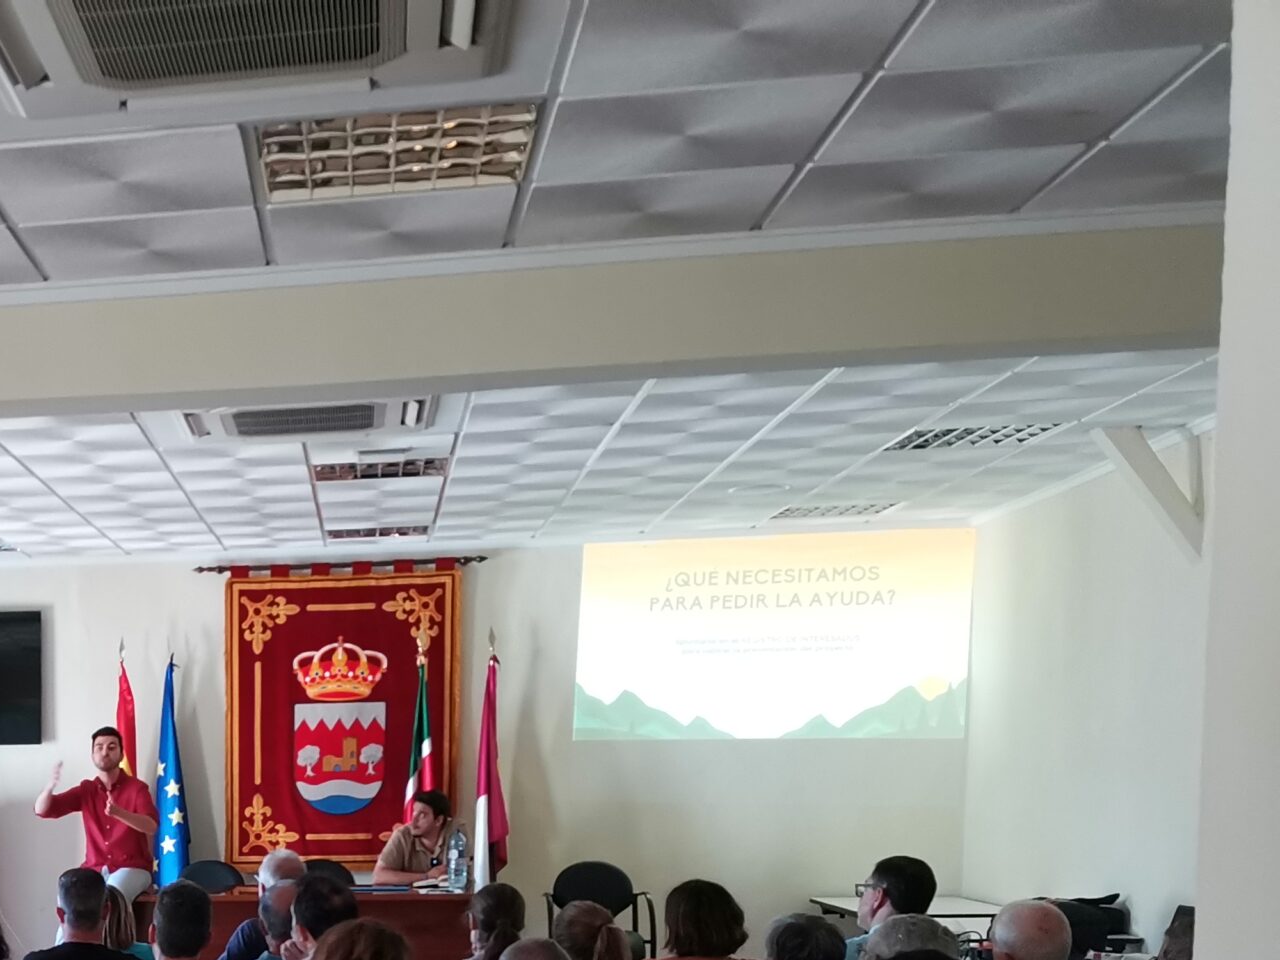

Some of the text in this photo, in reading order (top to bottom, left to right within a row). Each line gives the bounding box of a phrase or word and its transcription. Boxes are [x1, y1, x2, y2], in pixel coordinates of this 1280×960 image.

[725, 566, 880, 586] NECESITAMOS
[649, 589, 896, 612] PARA PEDIR LA AYUDA?
